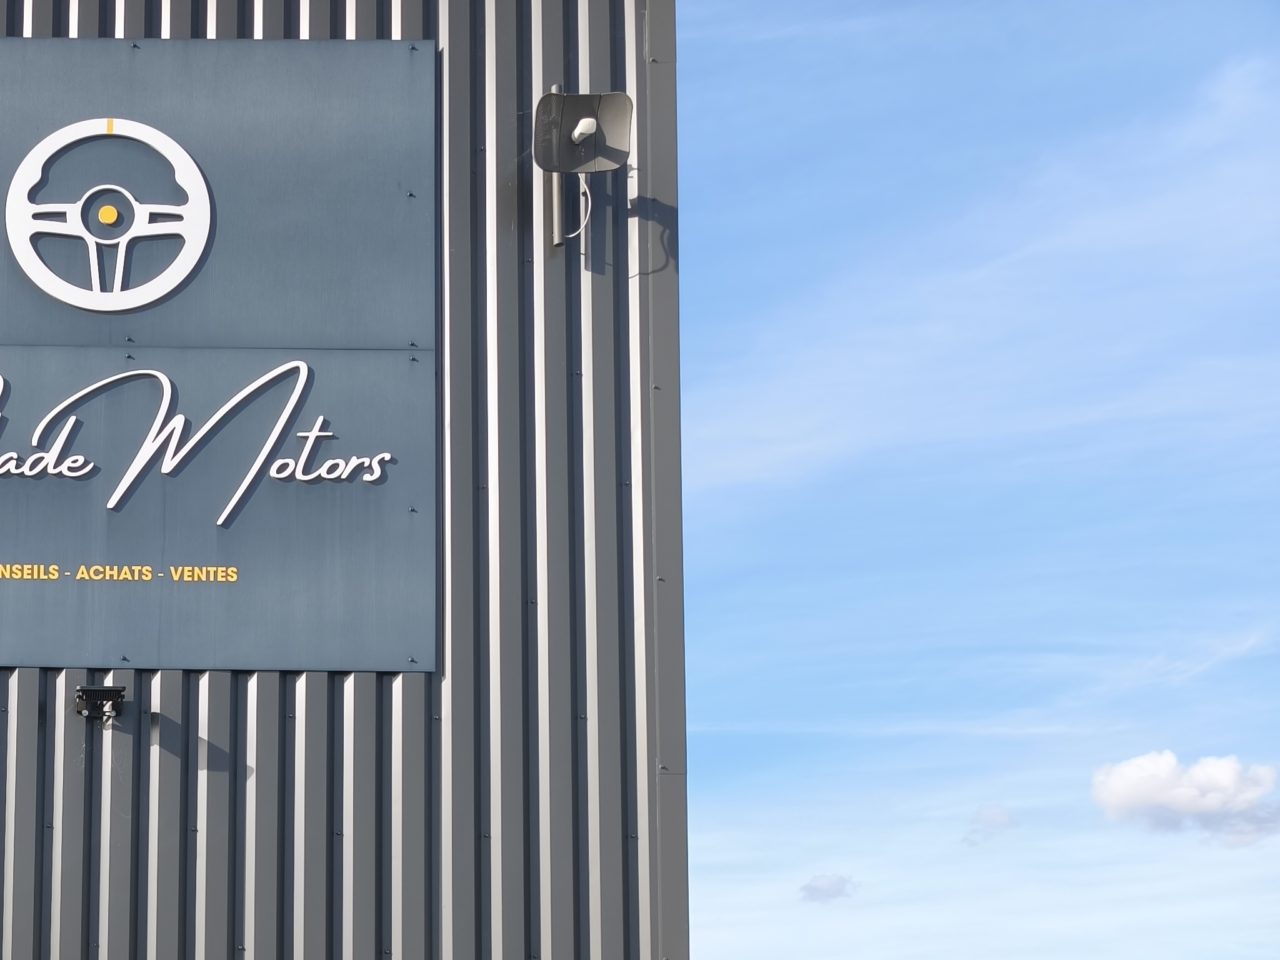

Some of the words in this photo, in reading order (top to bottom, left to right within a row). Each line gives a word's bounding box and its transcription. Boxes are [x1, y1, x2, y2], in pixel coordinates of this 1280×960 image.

[31, 360, 392, 526] Motors
[75, 565, 154, 582] ACHATS
[170, 565, 239, 583] VENTES
